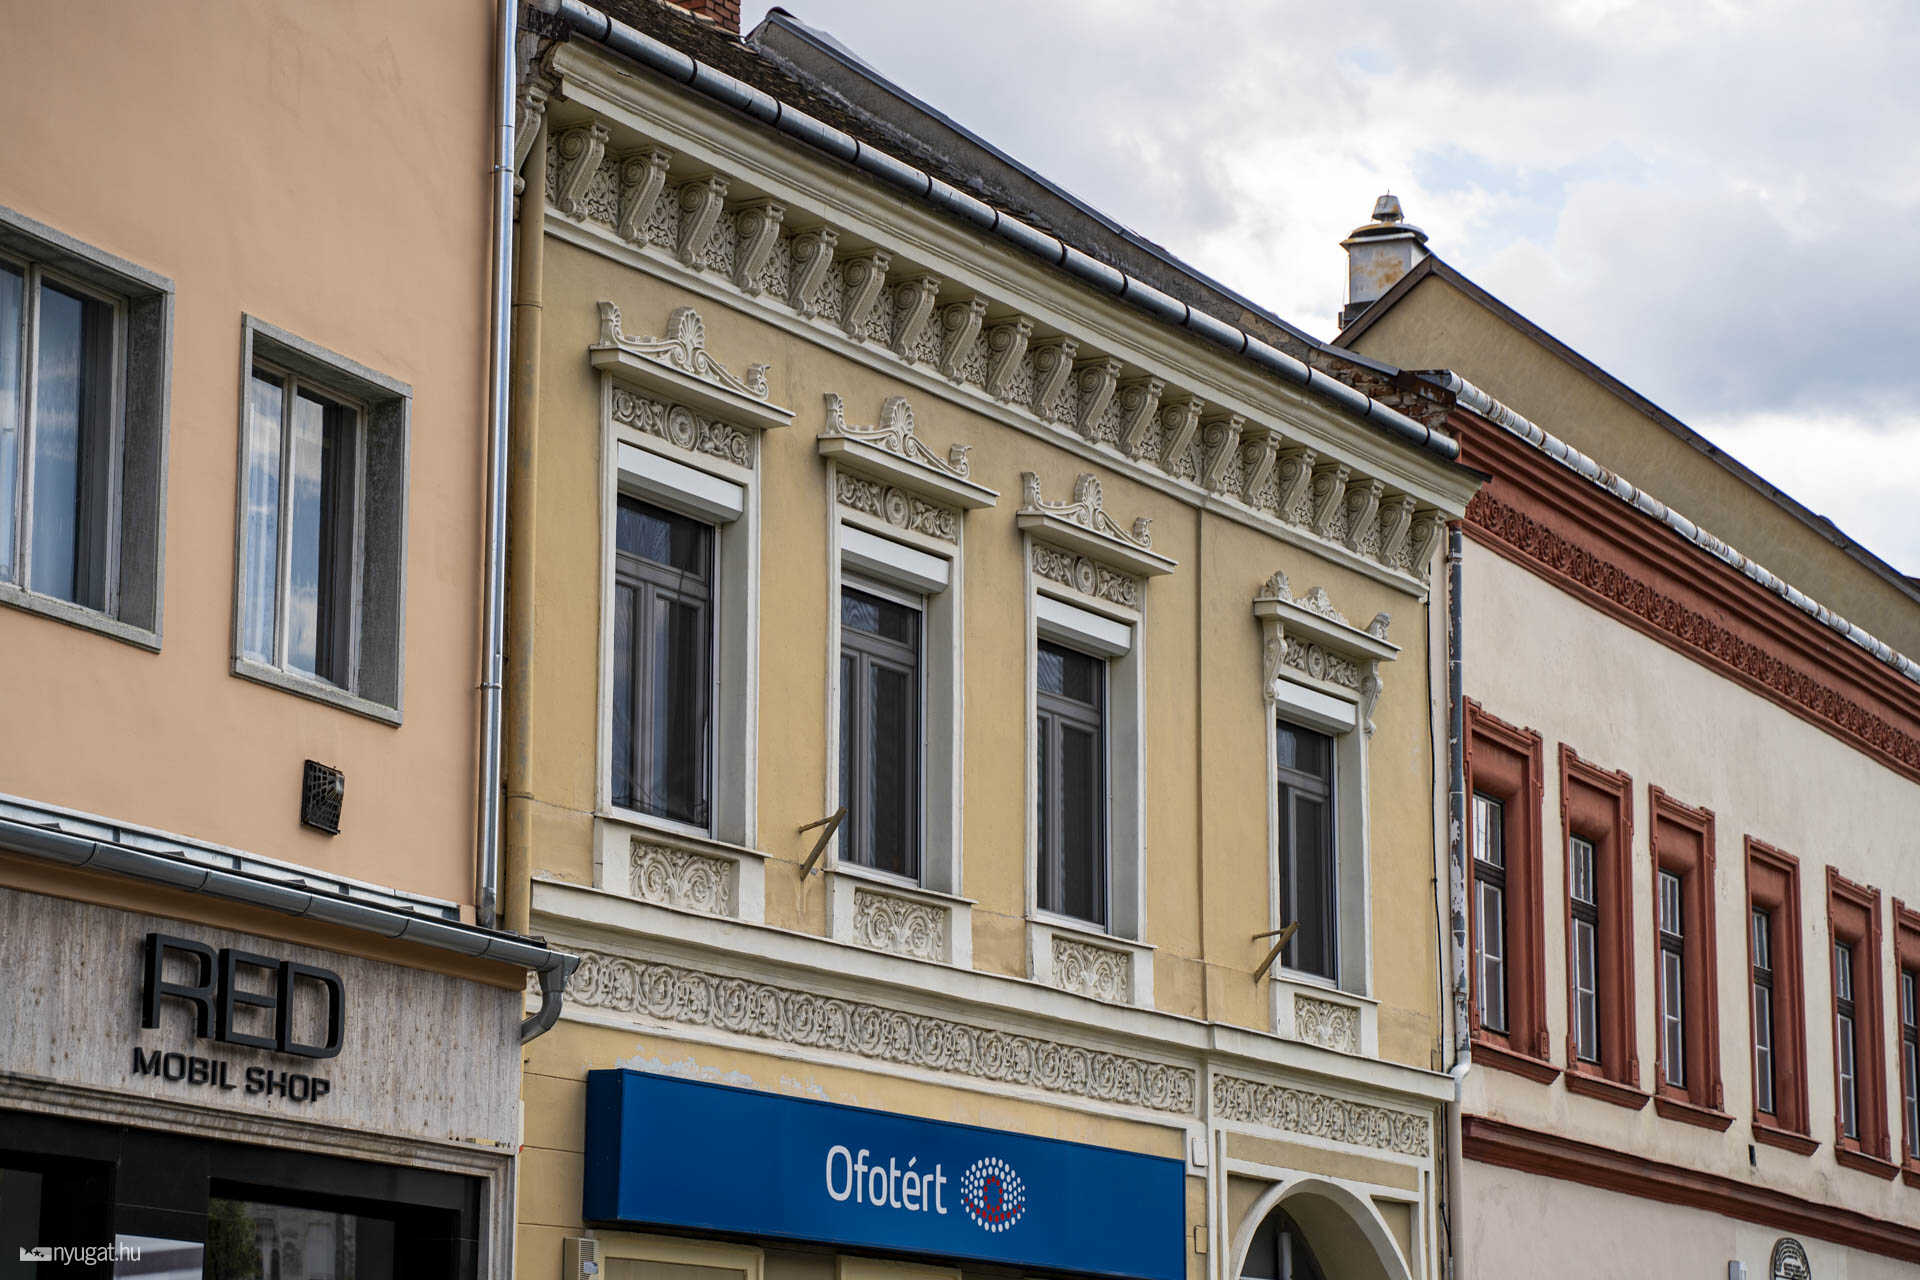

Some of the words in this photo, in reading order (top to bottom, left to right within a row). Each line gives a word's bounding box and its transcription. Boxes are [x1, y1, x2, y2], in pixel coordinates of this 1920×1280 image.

[142, 933, 345, 1059] RED
[133, 1047, 237, 1090] MOBIL
[245, 1066, 330, 1103] SHOP
[826, 1145, 948, 1214] Ofotért
